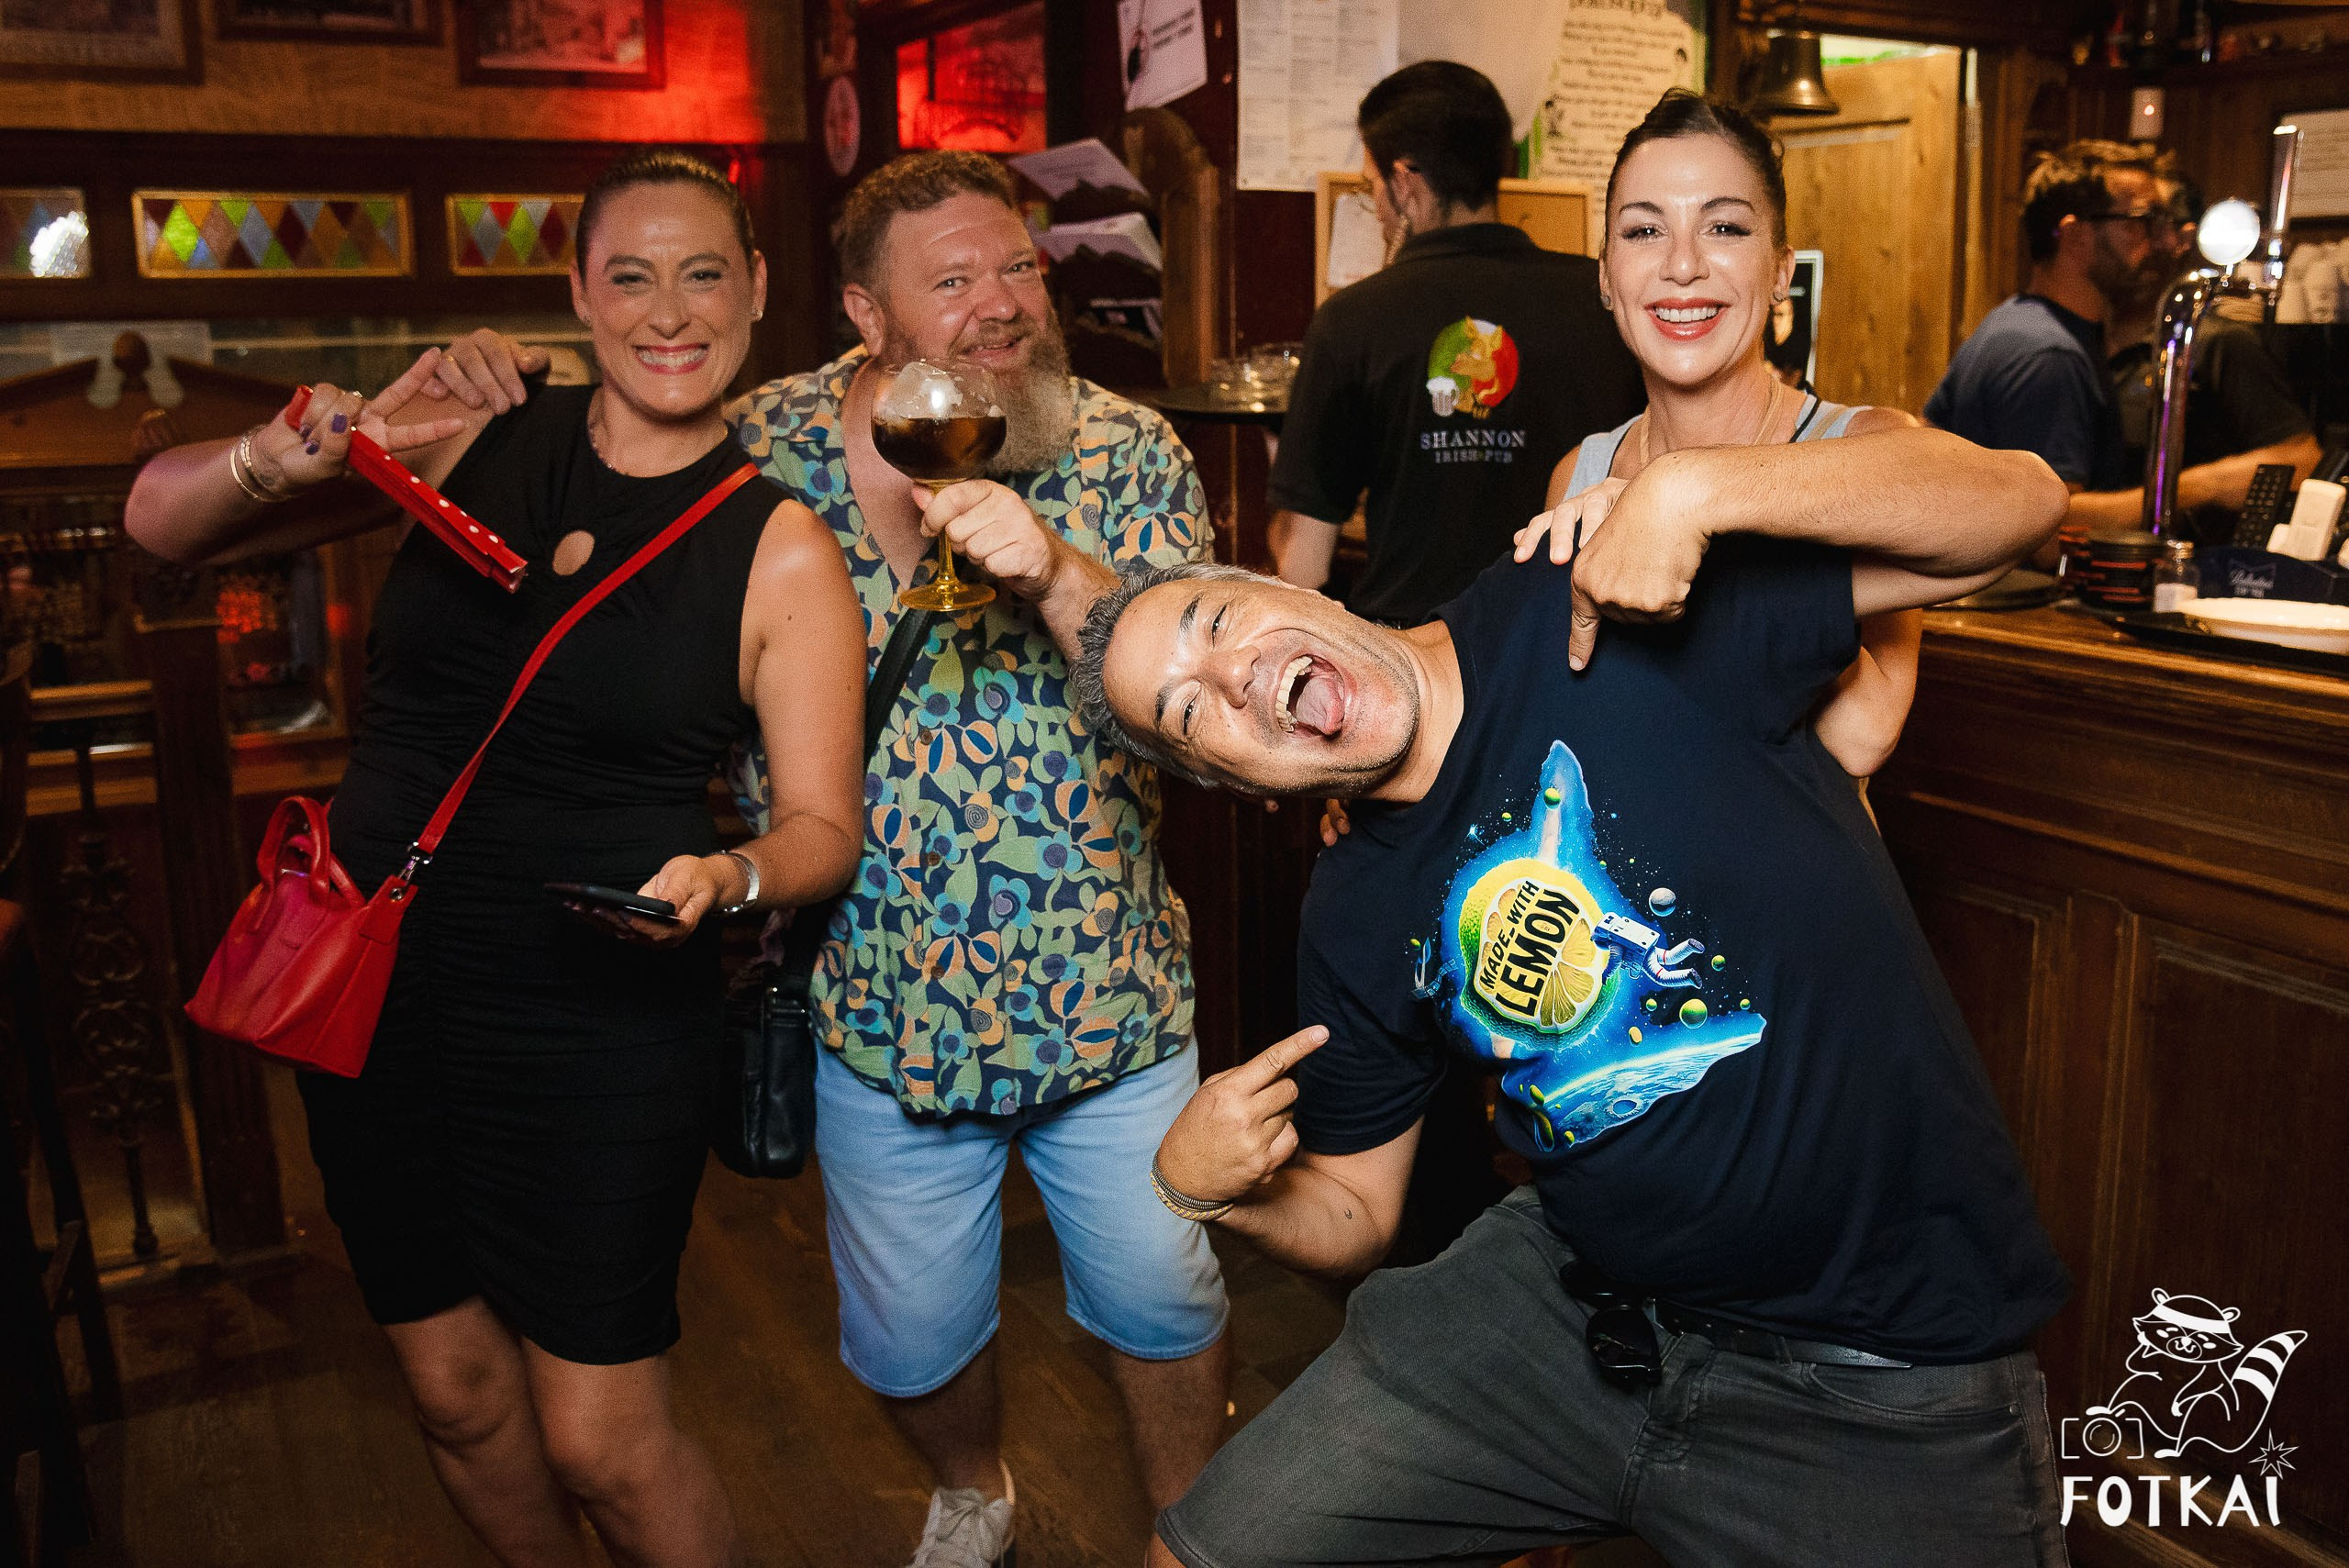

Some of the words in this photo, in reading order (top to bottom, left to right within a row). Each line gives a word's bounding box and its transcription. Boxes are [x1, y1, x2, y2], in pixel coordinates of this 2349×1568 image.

[1419, 429, 1525, 450] SHANNON
[1434, 449, 1478, 463] IRISH
[1484, 449, 1513, 463] PUB
[1495, 888, 1580, 1018] LEMON
